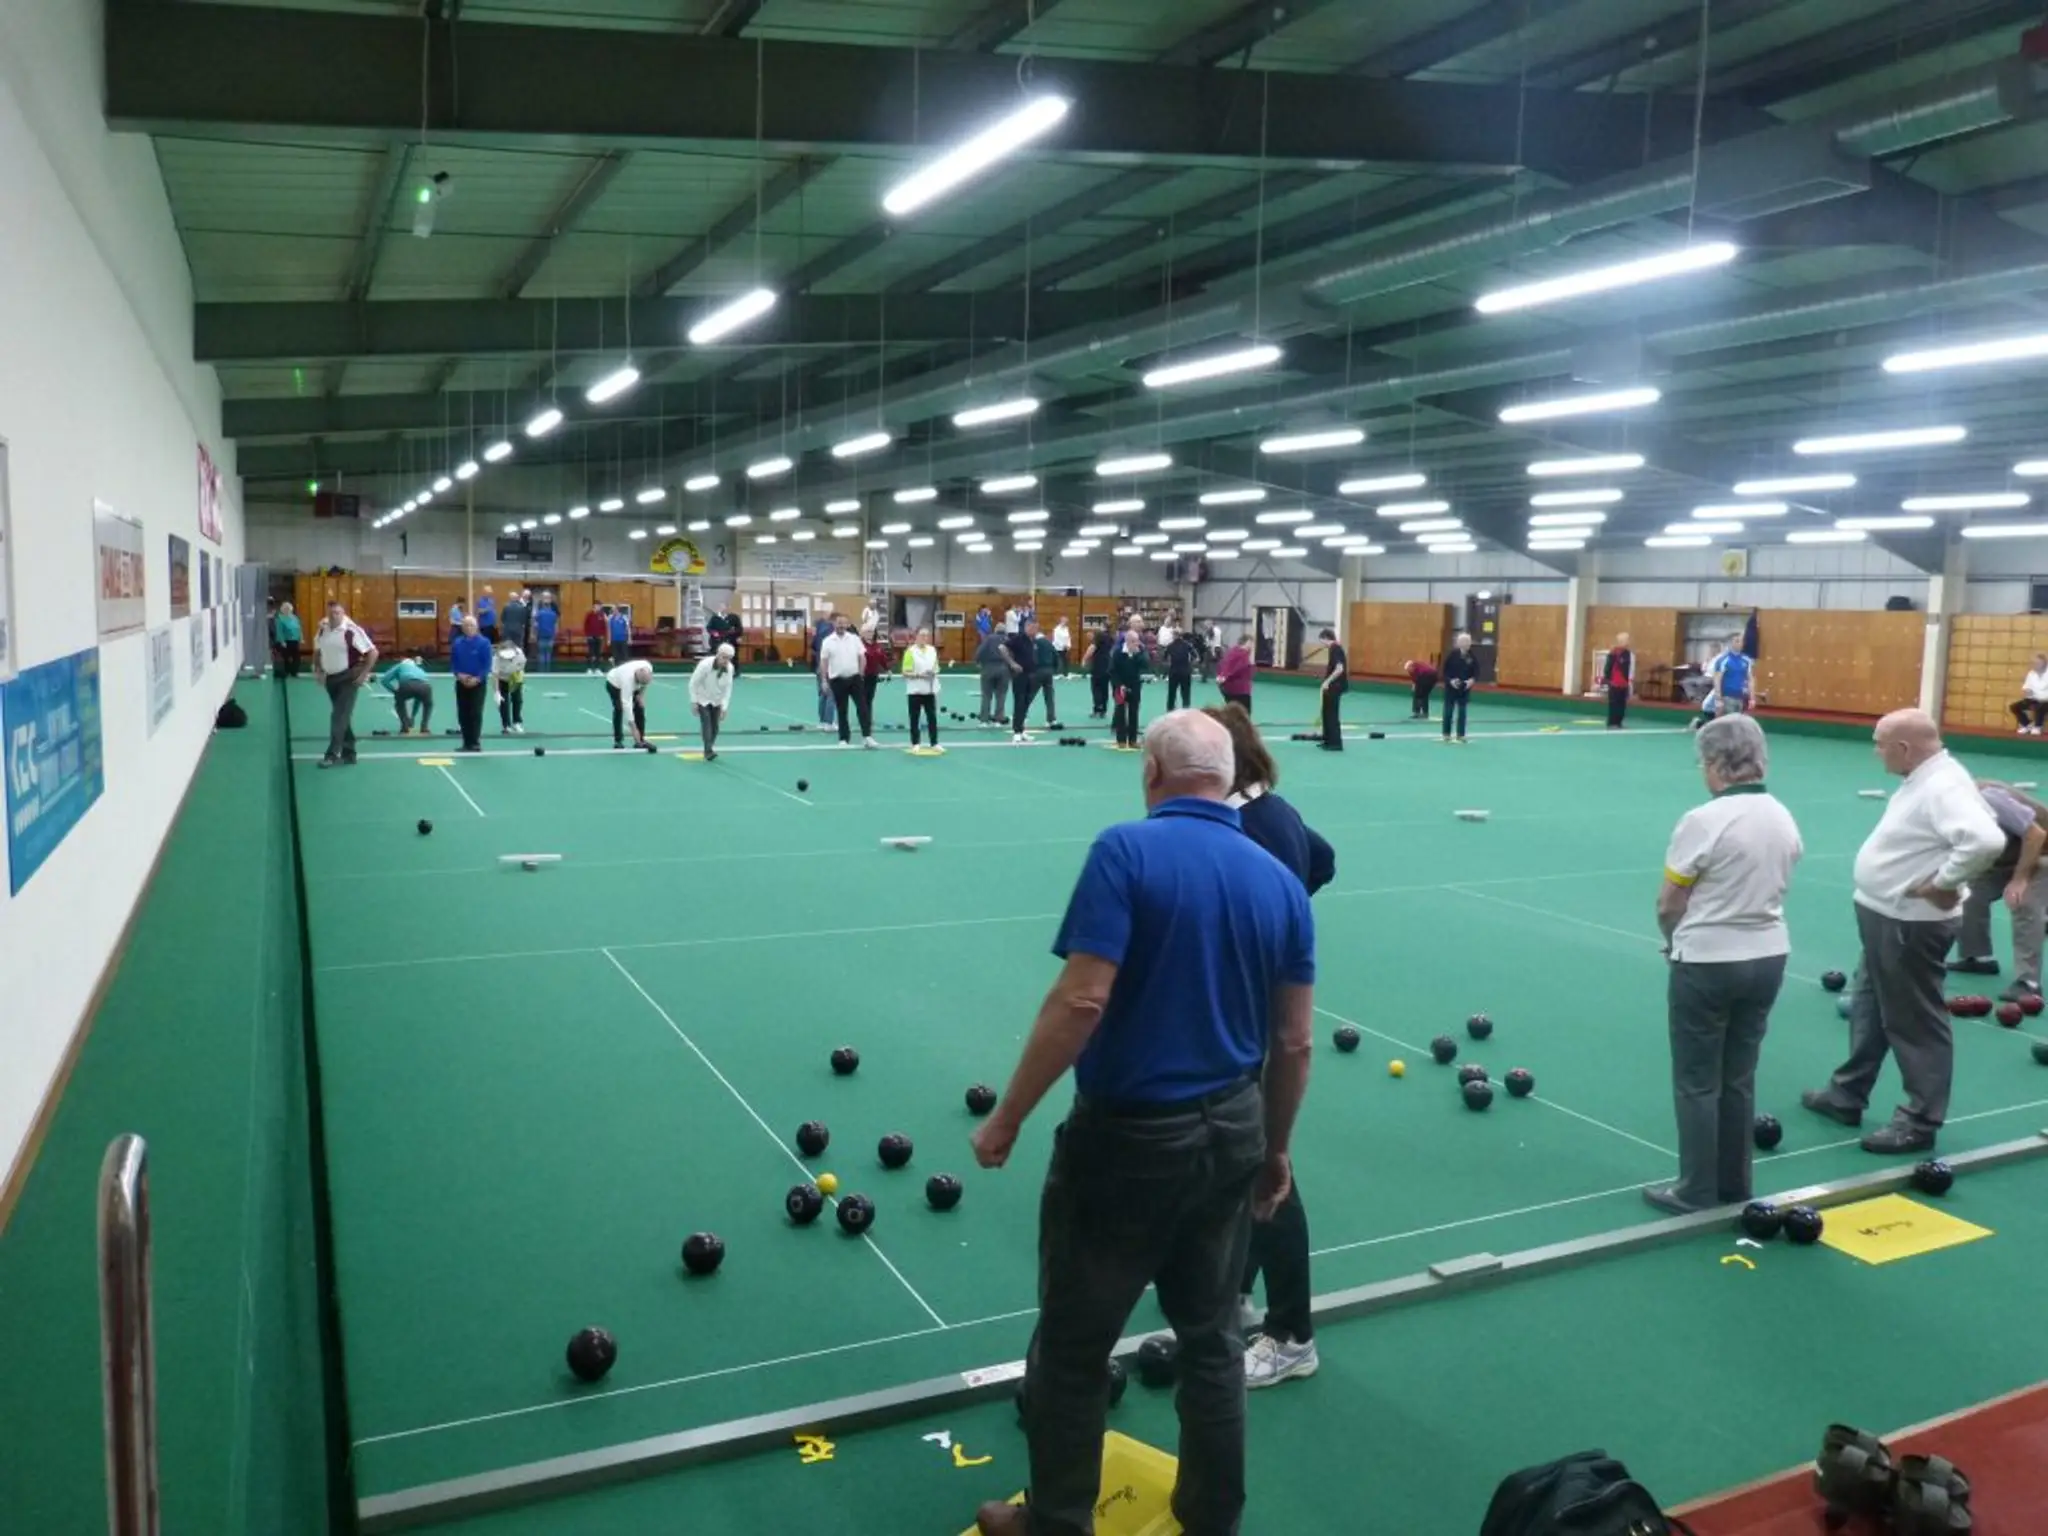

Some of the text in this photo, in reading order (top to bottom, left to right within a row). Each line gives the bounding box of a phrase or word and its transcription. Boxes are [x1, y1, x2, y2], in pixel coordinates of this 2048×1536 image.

[581, 537, 595, 562] 2
[714, 544, 727, 566] 3
[901, 552, 914, 574] 4
[1044, 556, 1055, 577] 5
